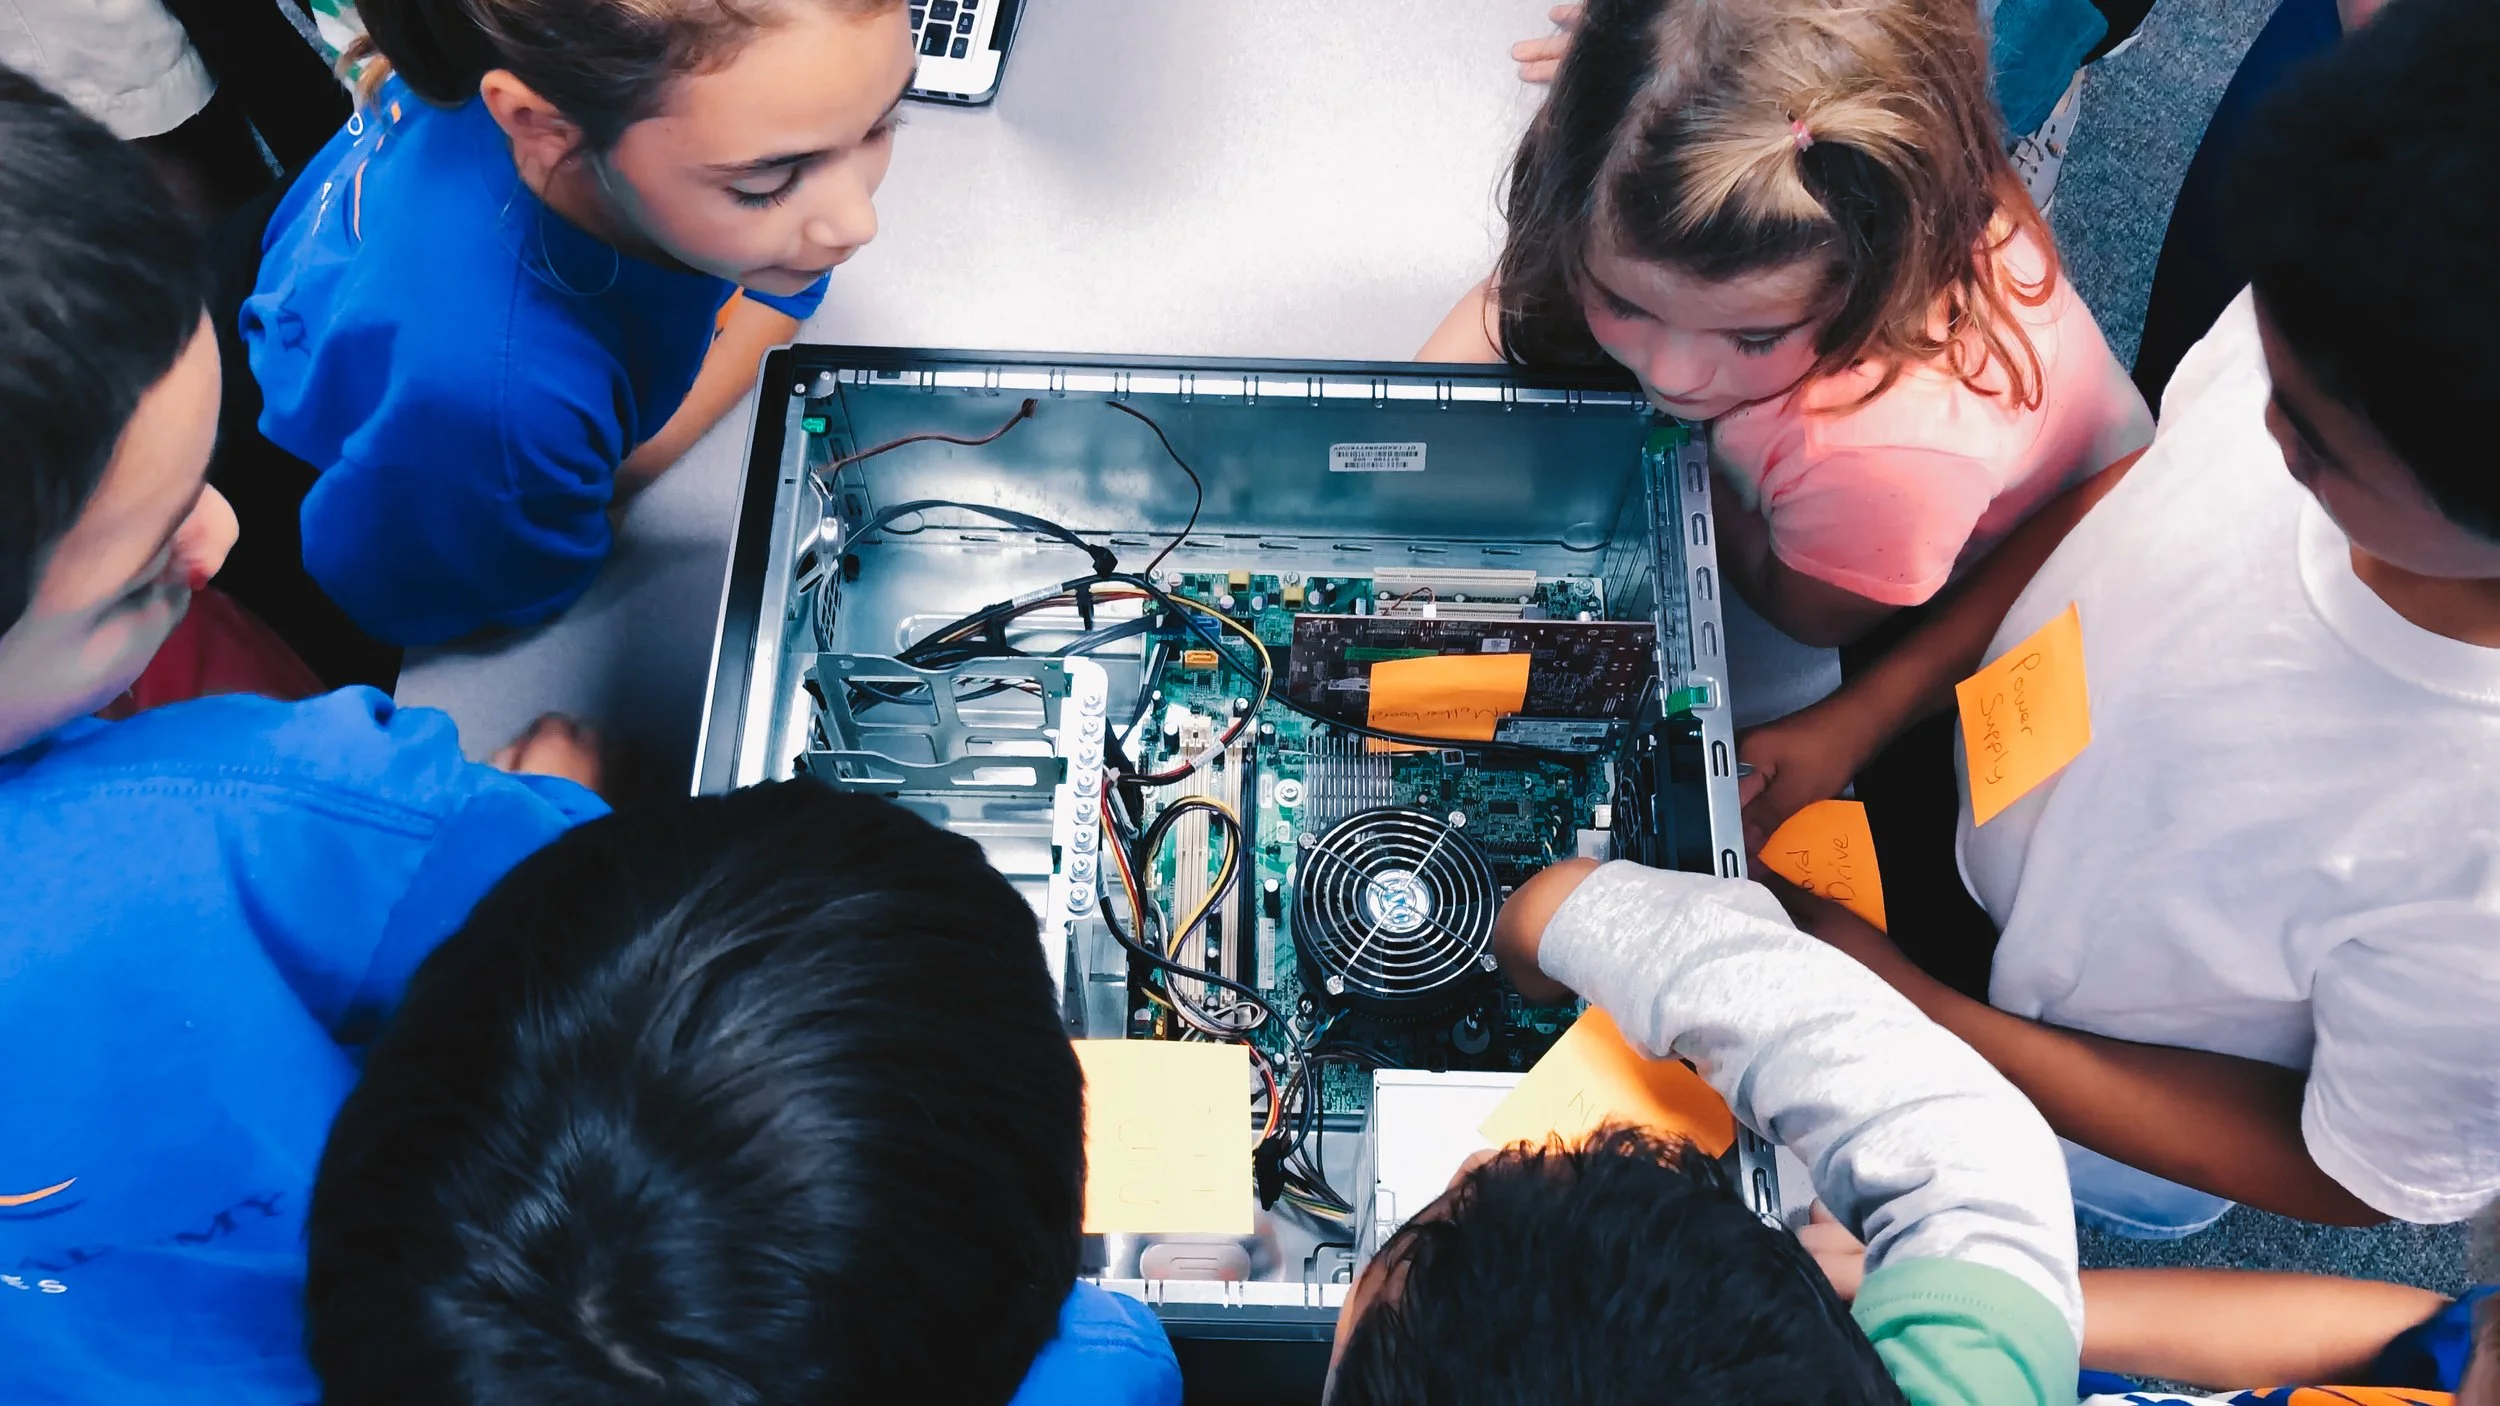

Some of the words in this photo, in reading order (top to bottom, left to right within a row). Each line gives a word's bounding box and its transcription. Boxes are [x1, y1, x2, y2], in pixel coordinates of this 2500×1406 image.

[2008, 652, 2041, 736] Power
[1980, 692, 2009, 785] Supply
[1785, 848, 1815, 893] ard
[1825, 832, 1857, 902] Drive
